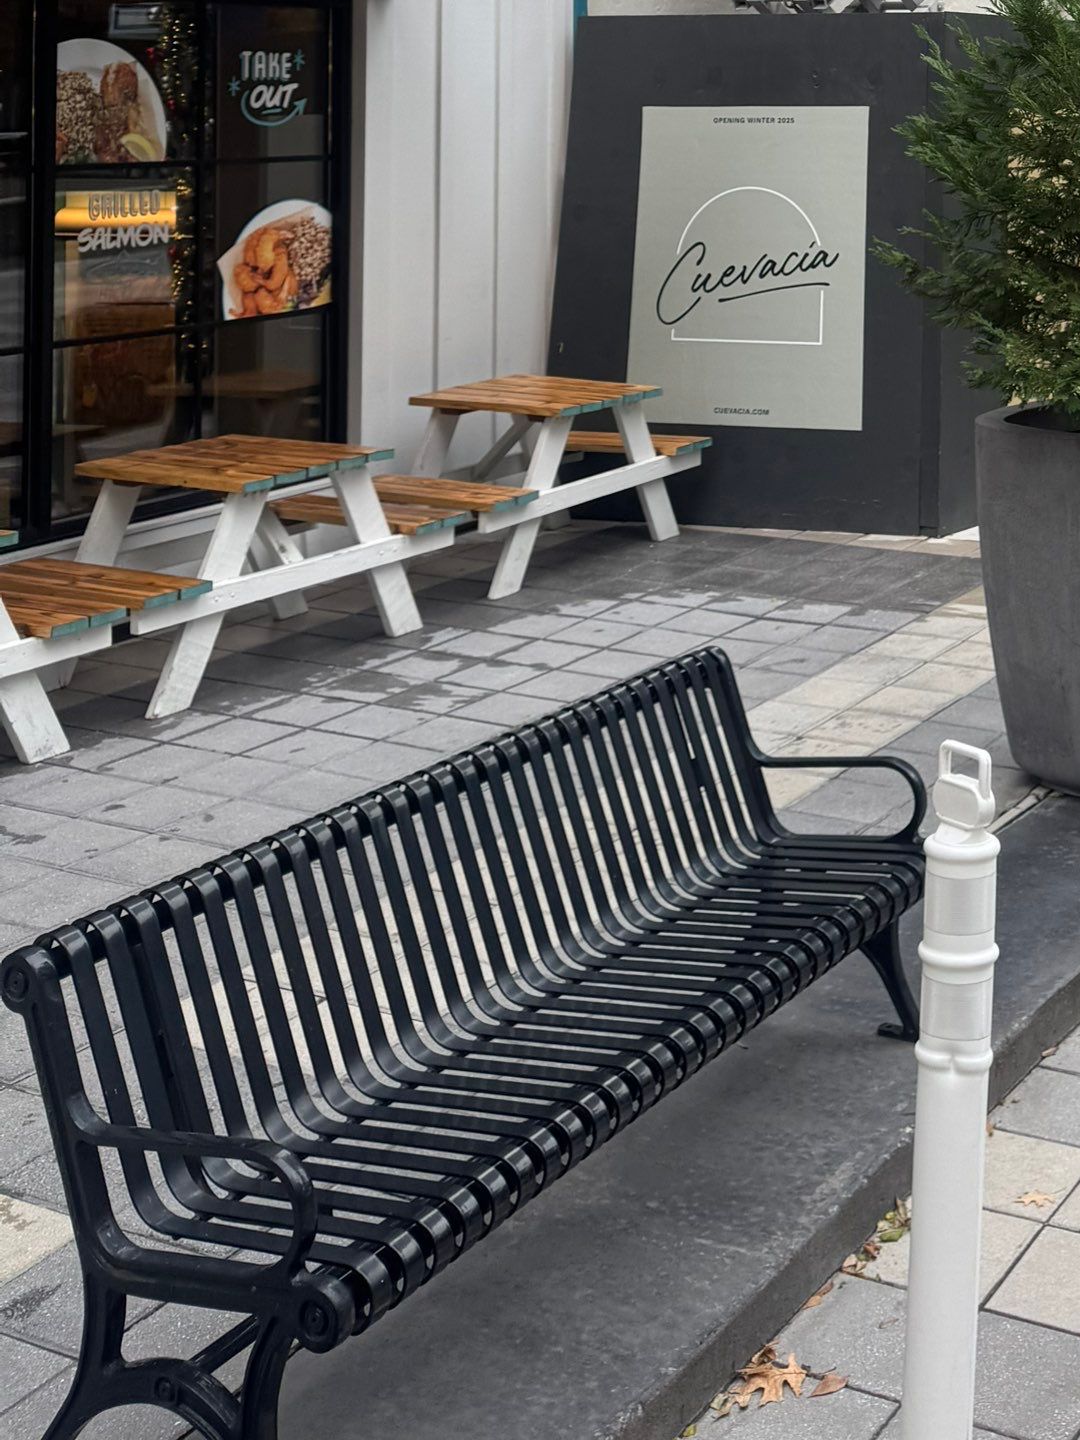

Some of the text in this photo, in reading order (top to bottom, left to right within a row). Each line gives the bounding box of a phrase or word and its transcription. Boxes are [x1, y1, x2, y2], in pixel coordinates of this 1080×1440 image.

[240, 50, 293, 80] TAKE
[249, 82, 299, 110] OUT
[713, 117, 796, 125] OPENING WINTER 2025
[88, 189, 161, 221] GRILLED
[77, 222, 170, 253] SALMON
